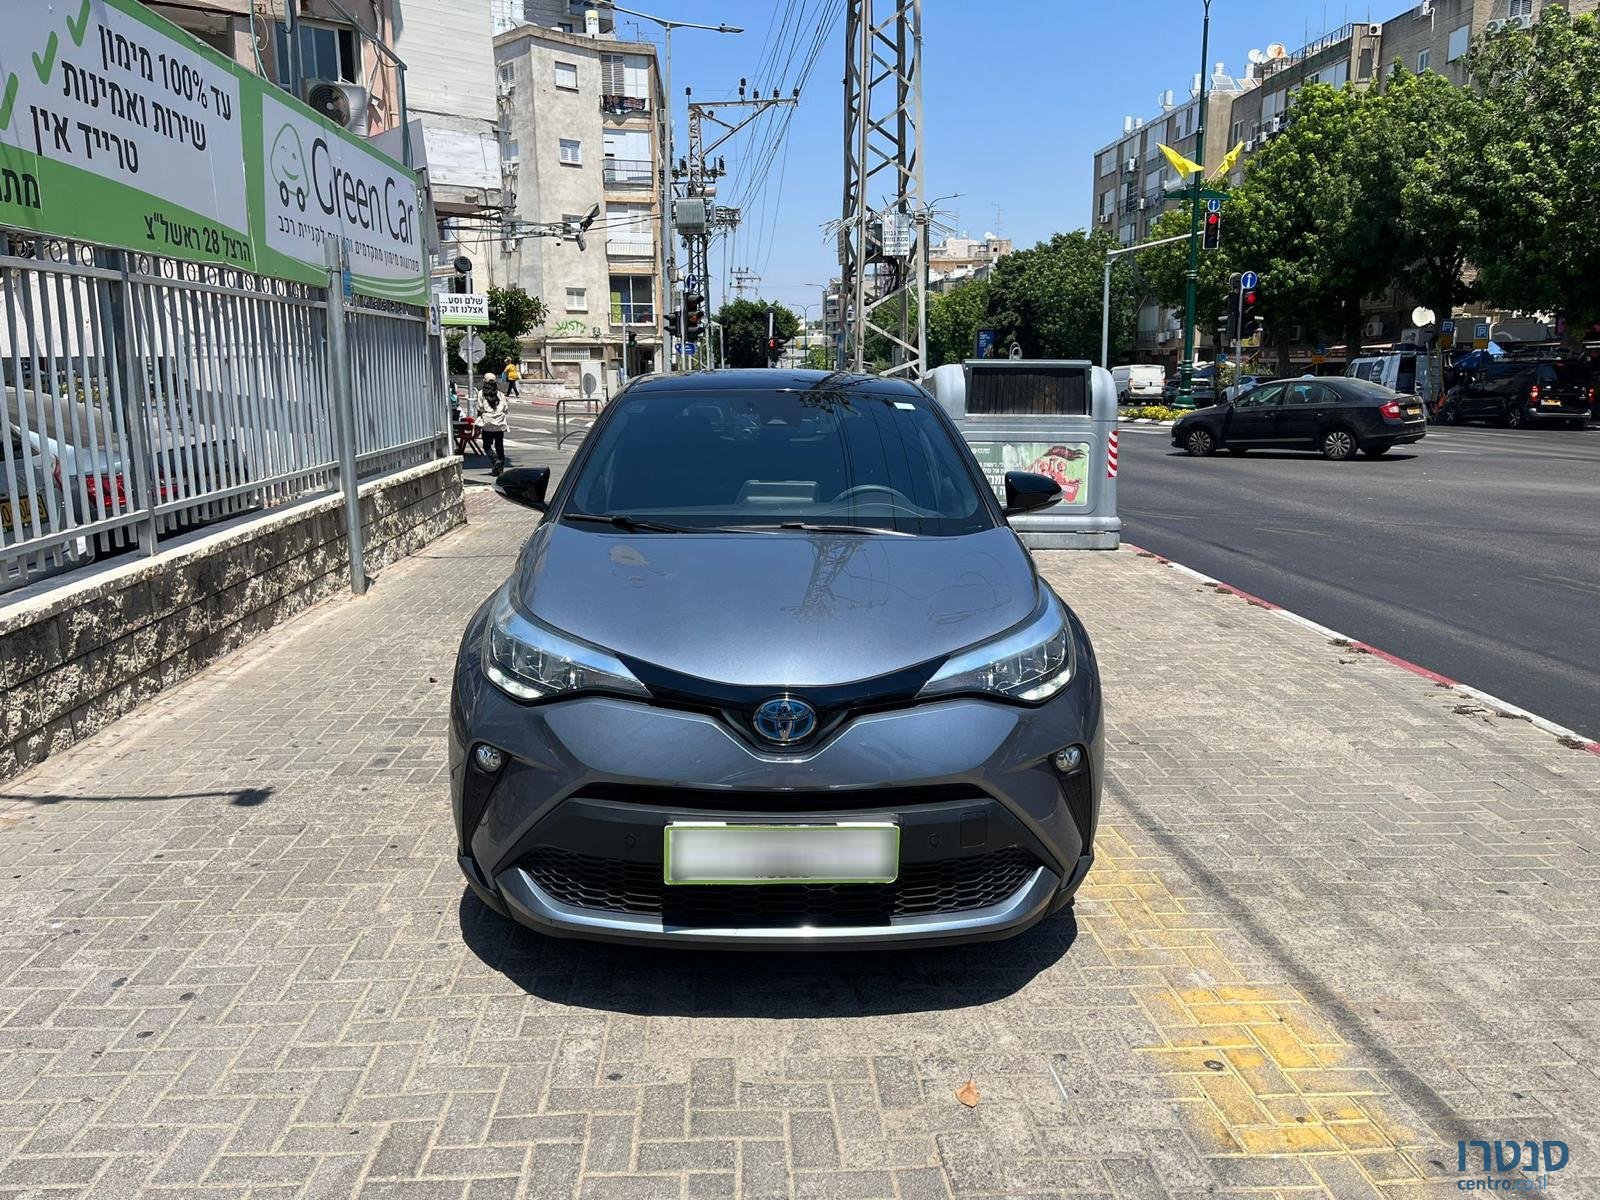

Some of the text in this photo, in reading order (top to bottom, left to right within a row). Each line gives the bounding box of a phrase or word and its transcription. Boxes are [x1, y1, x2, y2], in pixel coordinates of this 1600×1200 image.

[98, 24, 232, 121] עד 100% מימון
[61, 60, 207, 151] שירות ואמינות
[30, 105, 139, 174] טרייד אין
[0, 168, 41, 209] מת
[312, 137, 414, 245] Green Car
[202, 227, 220, 255] 28
[278, 215, 297, 235] רכב
[298, 225, 325, 248] לקניית
[221, 230, 252, 262] הרצל
[461, 305, 484, 314] אצלנו
[464, 296, 483, 305] שלם
